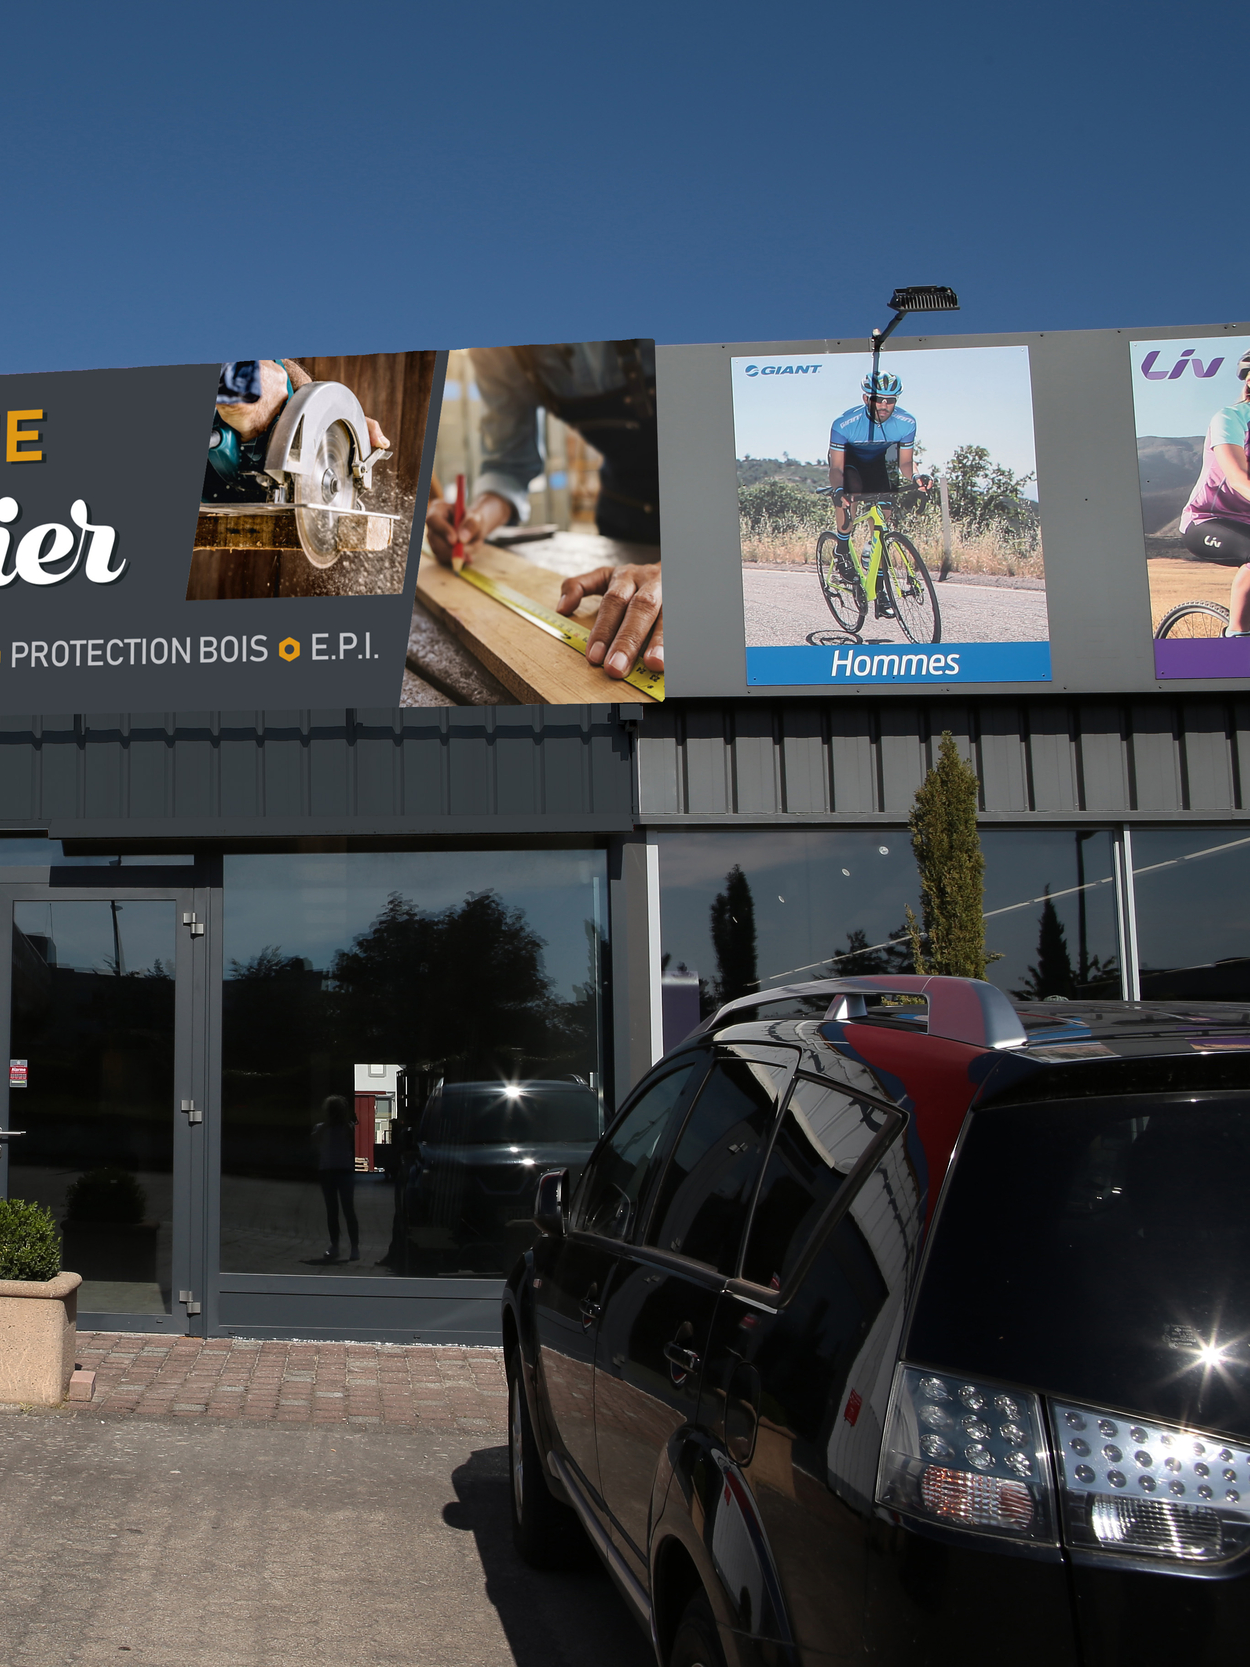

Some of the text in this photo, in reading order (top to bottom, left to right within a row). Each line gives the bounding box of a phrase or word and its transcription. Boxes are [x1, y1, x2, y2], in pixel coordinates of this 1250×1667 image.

[761, 365, 822, 375] GIANT
[1141, 349, 1225, 381] Liv
[1204, 535, 1222, 548] Liv
[12, 637, 190, 667] PROTECTION
[200, 635, 268, 663] BOIS
[312, 632, 378, 660] E.P.I.
[831, 649, 960, 677] Hommes
